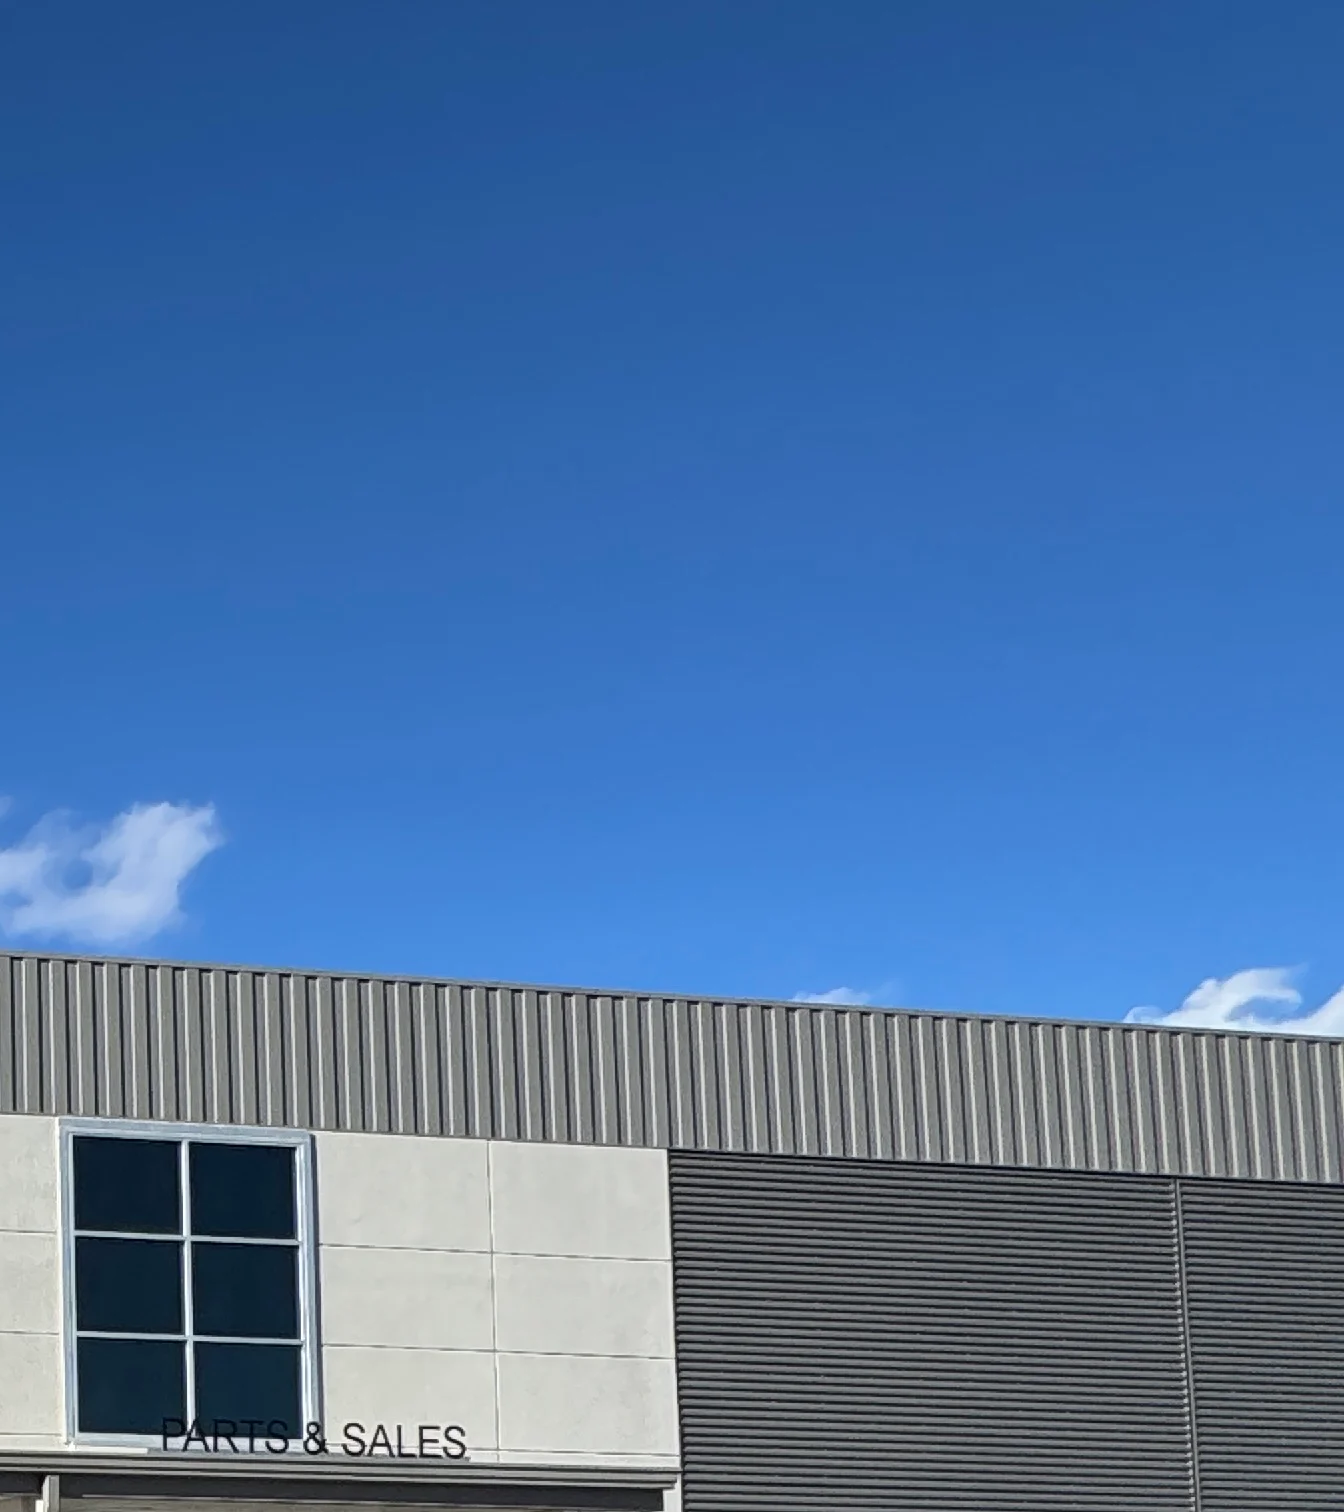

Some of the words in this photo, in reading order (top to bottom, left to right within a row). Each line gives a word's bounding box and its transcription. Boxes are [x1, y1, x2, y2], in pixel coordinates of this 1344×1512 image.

[162, 1417, 289, 1454] PARTS
[303, 1421, 329, 1456] &
[342, 1422, 467, 1459] SALES
